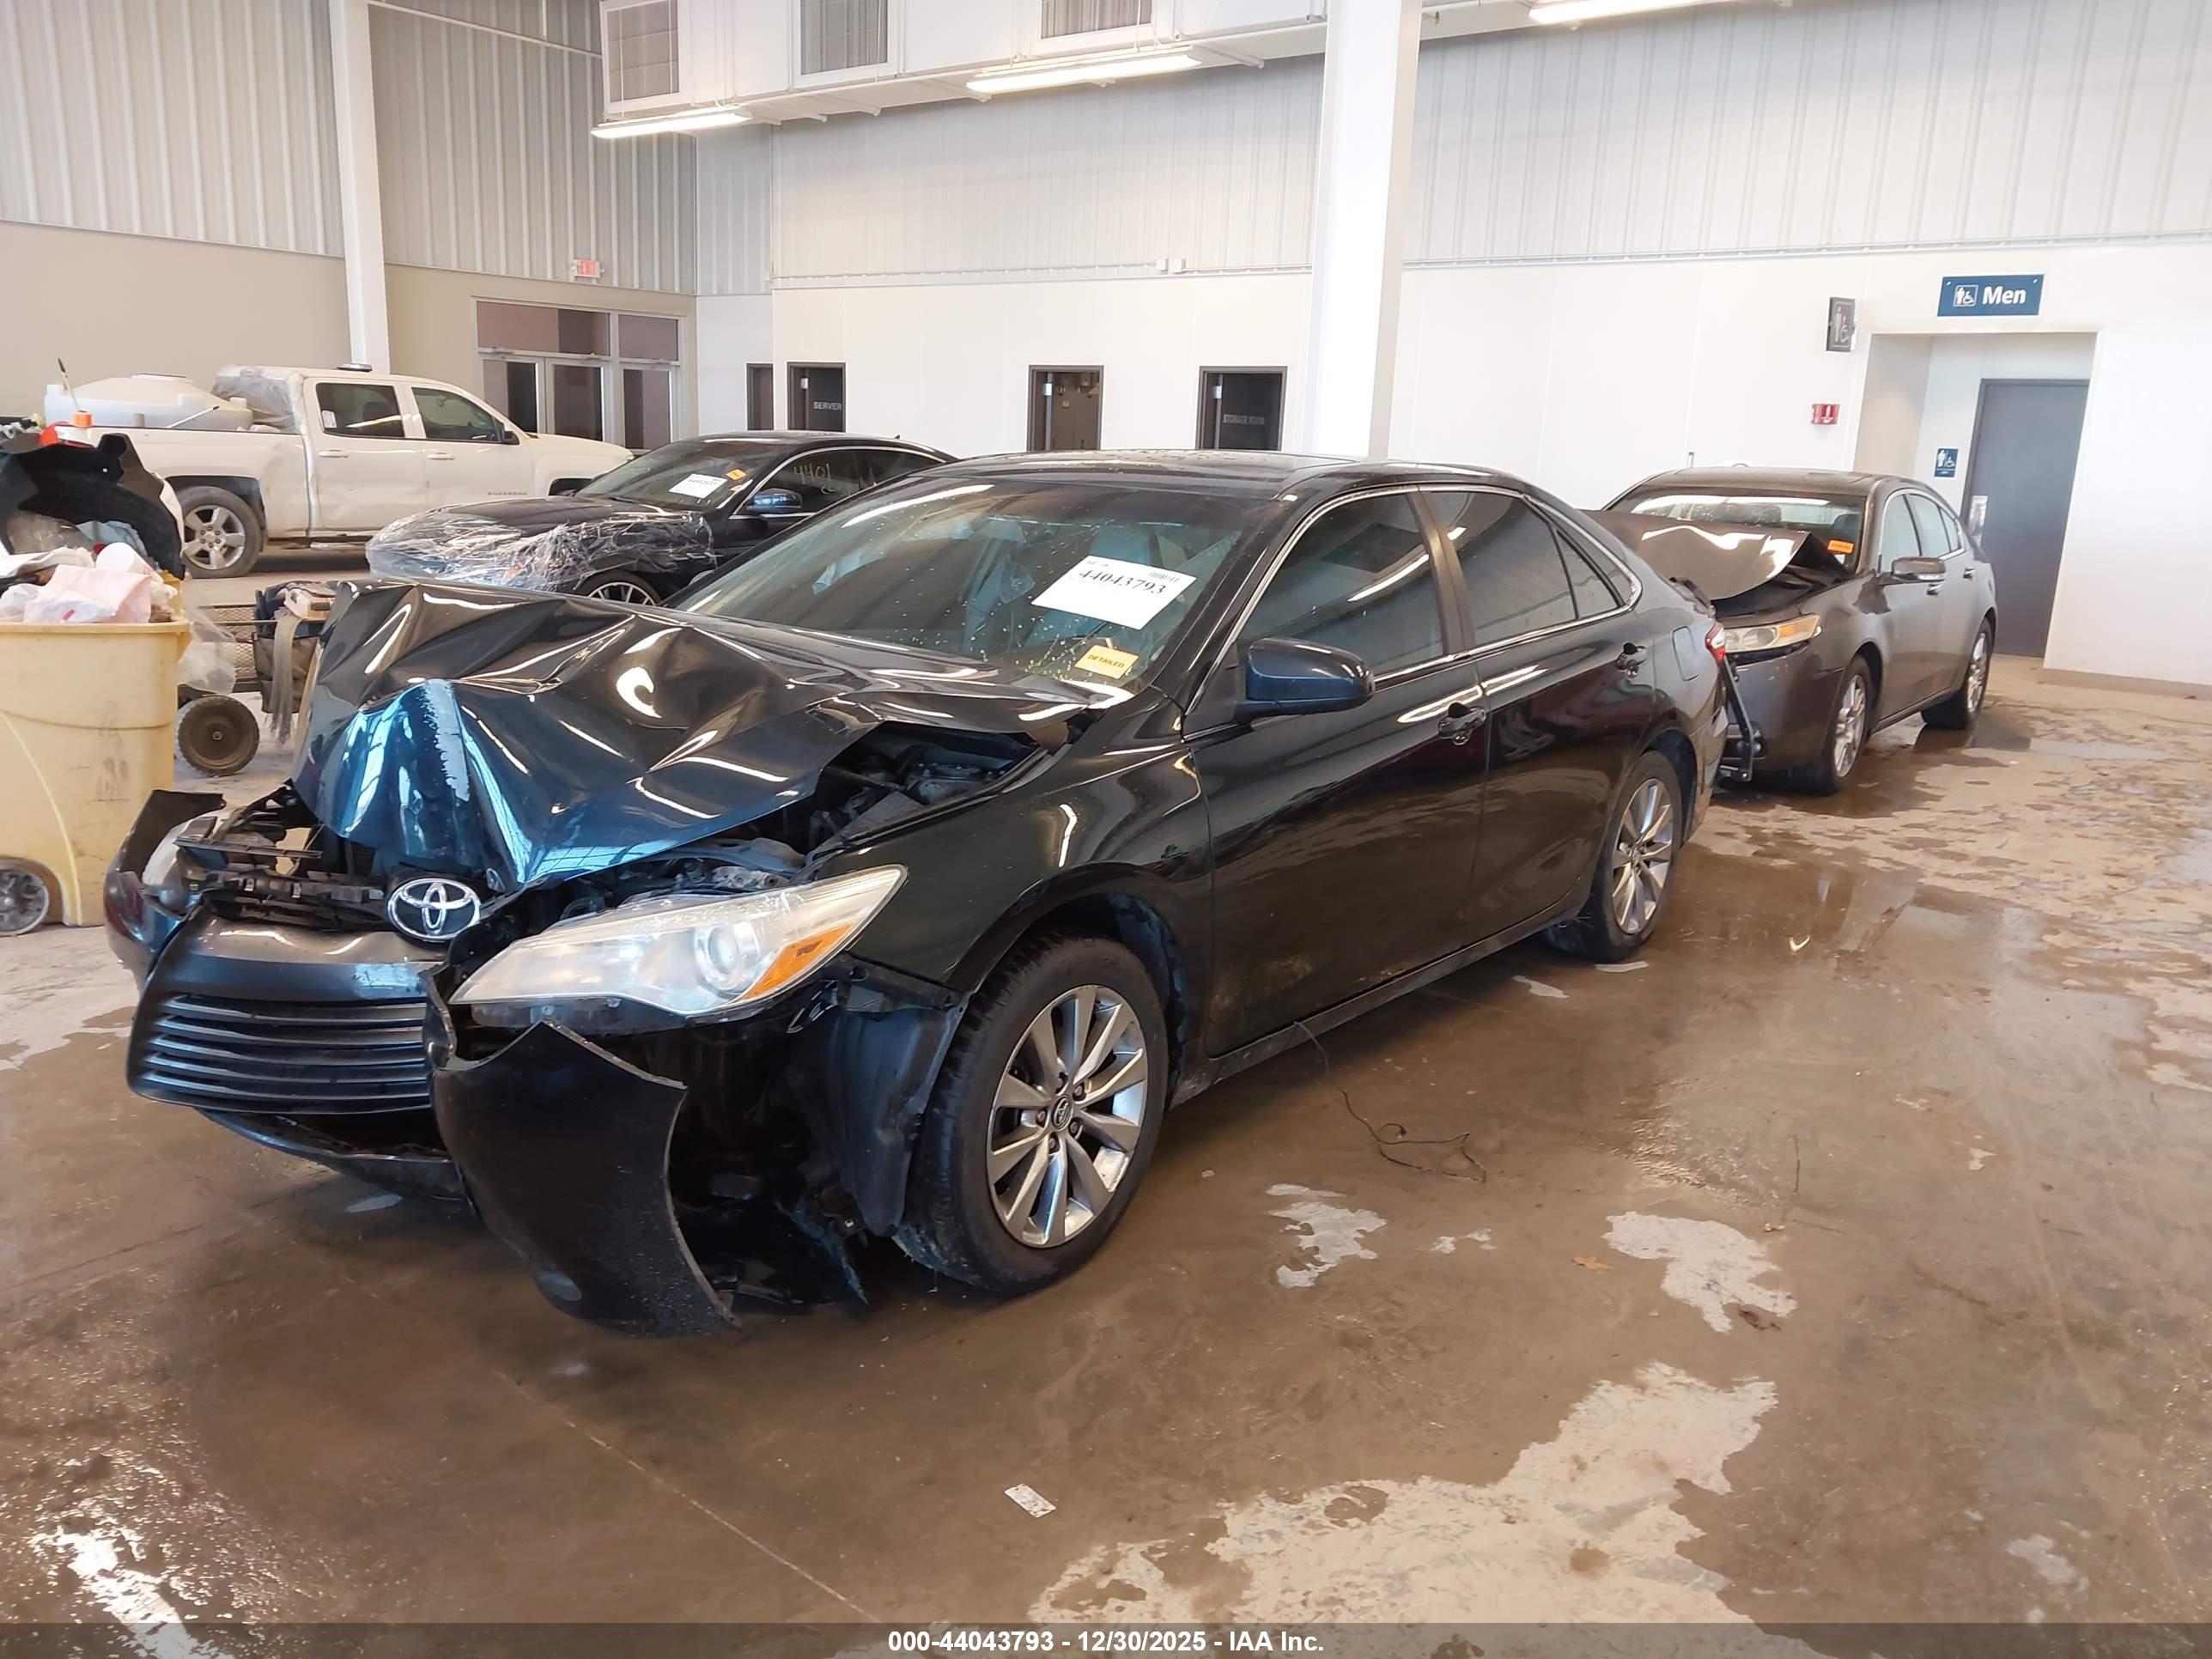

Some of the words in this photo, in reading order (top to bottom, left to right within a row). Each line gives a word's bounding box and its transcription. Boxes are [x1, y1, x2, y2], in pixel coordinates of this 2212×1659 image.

[1982, 285, 2027, 305] Men
[813, 401, 842, 410] SERVER
[1079, 569, 1166, 593] 44043793
[1087, 654, 1125, 668] DETAILED
